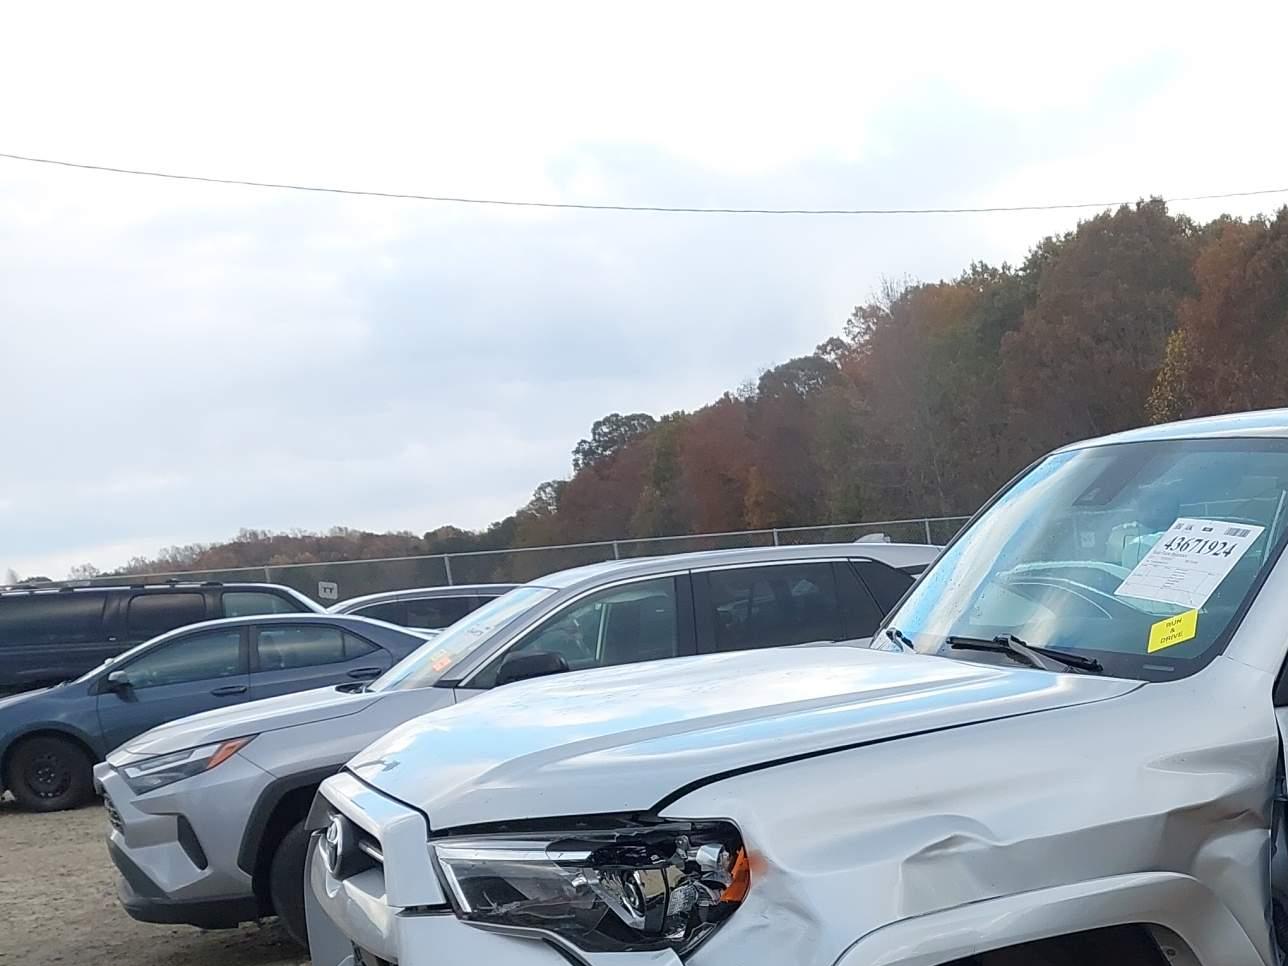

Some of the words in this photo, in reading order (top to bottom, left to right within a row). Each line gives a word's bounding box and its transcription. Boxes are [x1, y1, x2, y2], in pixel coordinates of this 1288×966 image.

[1164, 536, 1238, 557] 43671924
[1166, 618, 1182, 628] RUN
[1160, 632, 1183, 643] DRIVE
